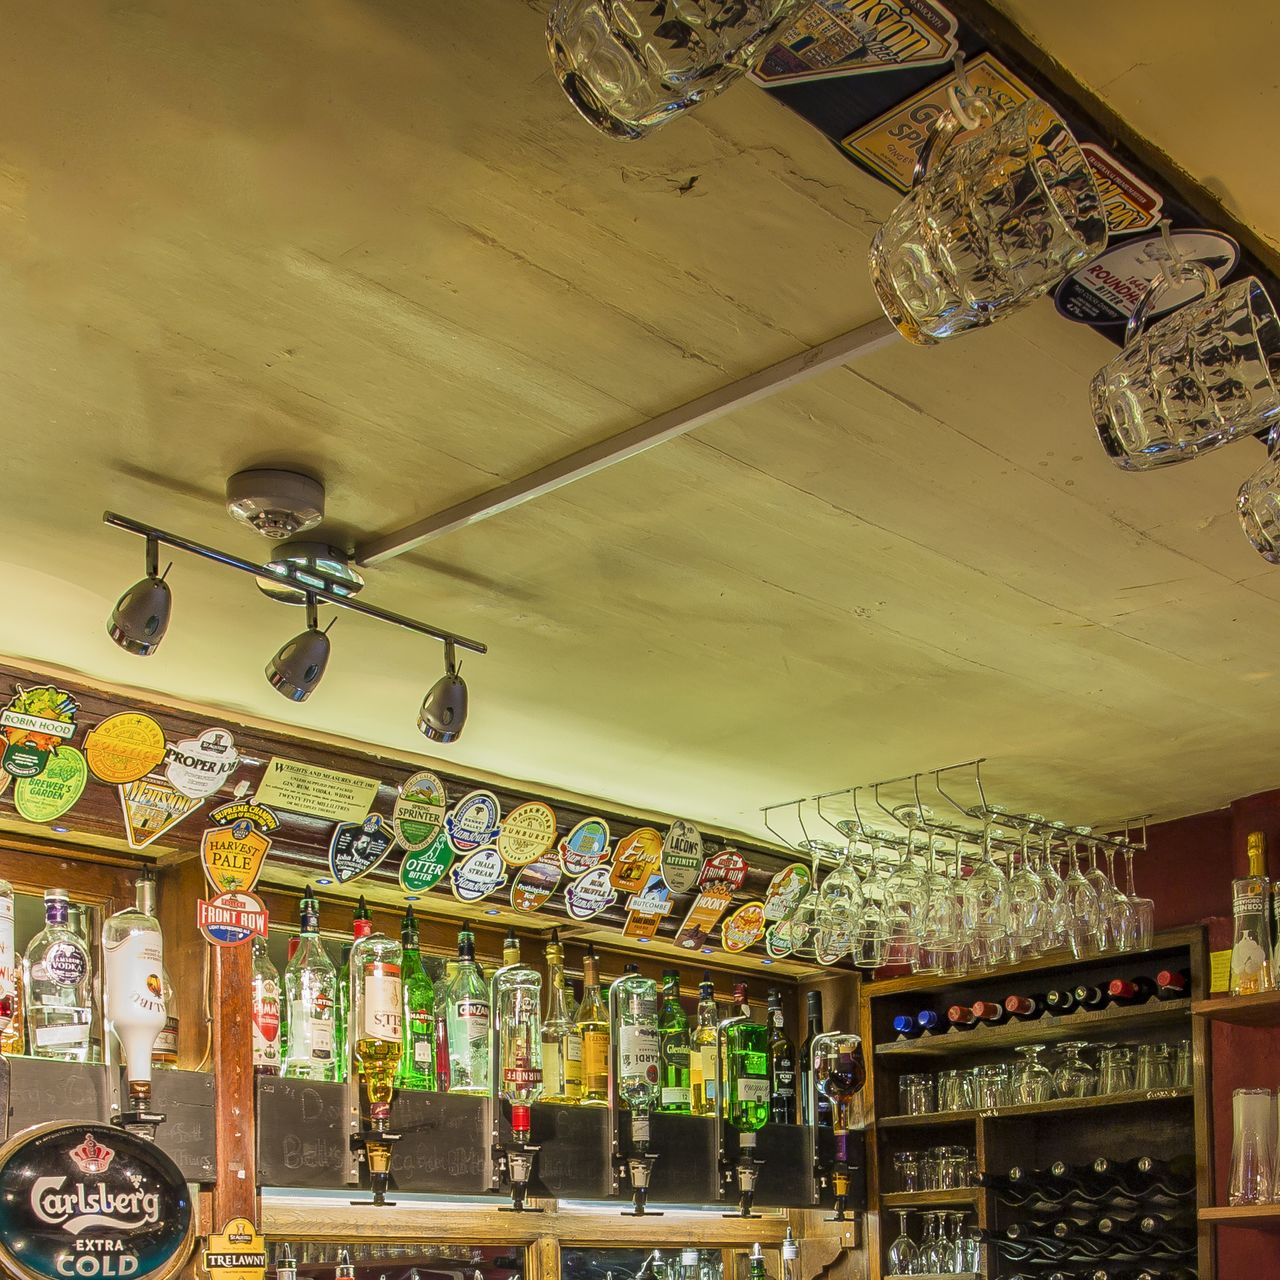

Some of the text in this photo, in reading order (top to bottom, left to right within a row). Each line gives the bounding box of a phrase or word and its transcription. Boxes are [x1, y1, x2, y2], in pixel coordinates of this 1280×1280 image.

[4, 714, 70, 735] ROBIN HOOD
[168, 750, 217, 773] PROPER
[275, 762, 352, 784] WEIGHTS MEASURES
[28, 778, 73, 793] BREWER'S
[30, 788, 65, 801] GARDEN
[397, 807, 441, 823] SPRINTER
[412, 803, 431, 811] SPRING
[214, 804, 277, 829] SUPREME CHAMPION
[449, 825, 491, 843] Ramsbury
[502, 826, 551, 843] SUNBURST
[210, 841, 260, 857] HARVEST
[670, 835, 699, 854] LACONS
[212, 852, 252, 870] PALE
[406, 859, 444, 875] OTTER
[474, 860, 497, 870] CHALK
[666, 856, 698, 867] AFFINITY
[408, 872, 433, 881] BITTER
[468, 867, 494, 878] STREAM
[456, 875, 494, 894] Ramsbury
[632, 900, 668, 912] BUTCOMBE
[697, 897, 726, 911] HOOKY
[202, 904, 265, 933] FRONT ROW
[52, 962, 83, 973] VODKA
[31, 1175, 160, 1235] Carlsberg
[75, 1239, 124, 1251] EXTRA
[56, 1255, 139, 1277] COLD
[208, 1254, 265, 1268] TRELAWNY
